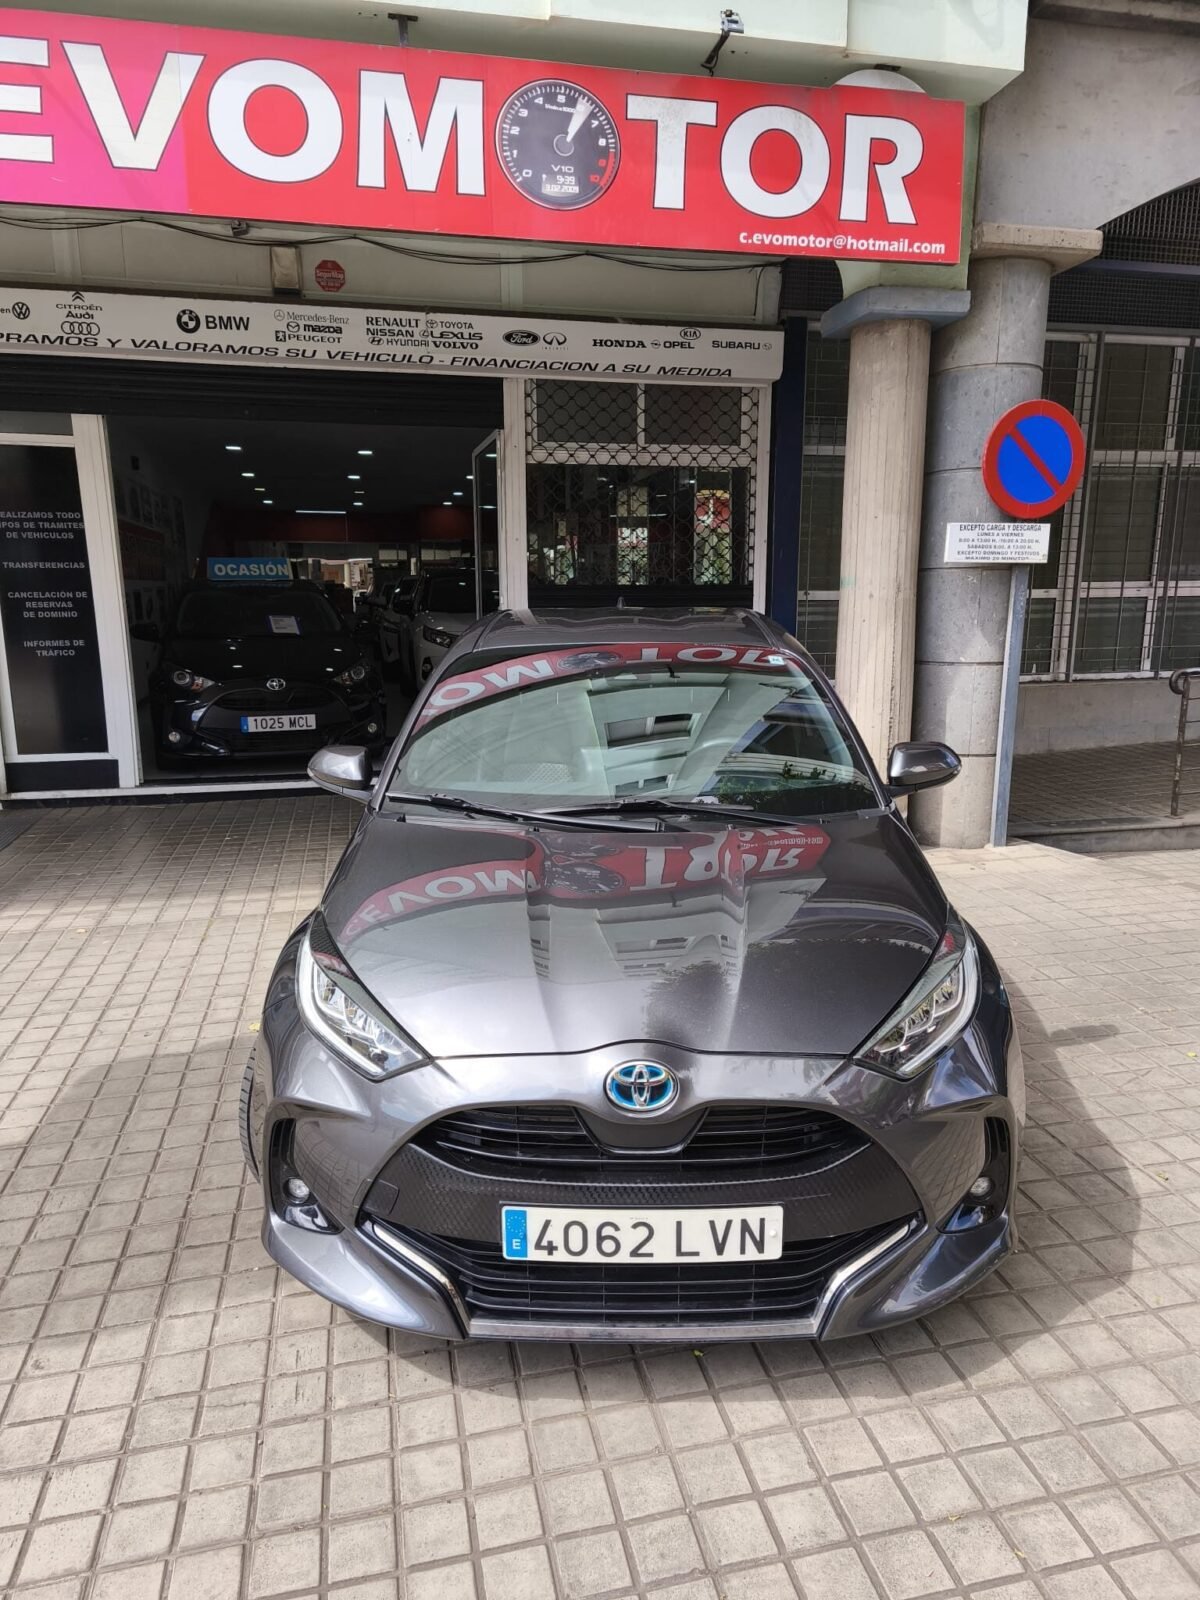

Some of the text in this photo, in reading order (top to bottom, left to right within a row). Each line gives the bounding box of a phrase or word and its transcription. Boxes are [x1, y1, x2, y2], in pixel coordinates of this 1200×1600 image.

[518, 108, 528, 117] 3
[510, 126, 520, 135] 2
[551, 164, 574, 173] V10
[739, 231, 945, 254] c.evomotor@hotmail.com
[65, 311, 94, 320] Audi
[287, 311, 349, 325] Mercedes-Benz
[205, 315, 250, 331] BMW
[366, 316, 421, 328] RENAULT
[439, 320, 474, 330] TOYOTA
[303, 323, 343, 334] mazda
[366, 327, 414, 338] NISSAN
[683, 330, 698, 338] KIA
[288, 333, 342, 344] PEUGEOT
[430, 330, 483, 341] LEXUS
[510, 332, 534, 344] Ford
[386, 338, 430, 347] HYUNDAI
[432, 340, 479, 350] VOLVO
[592, 338, 647, 349] HONDA
[663, 341, 695, 349] OPEL
[712, 340, 761, 350] SUBARU
[106, 338, 123, 348] Y
[131, 338, 278, 358] VALORAMOS
[285, 348, 318, 359] SU
[326, 350, 434, 365] VEHICULO
[450, 356, 598, 372] FINANCIACION
[603, 364, 616, 372] A
[622, 364, 651, 374] SU
[657, 366, 733, 377] MEDIDA
[0, 511, 53, 519] EALIZAMOS
[2, 561, 85, 569] TRANSFERENCIAS
[214, 561, 288, 576] OCASIÓN
[252, 716, 313, 730] 1025 MCL
[533, 1217, 766, 1258] 4062 LVN
[512, 1238, 521, 1250] E
